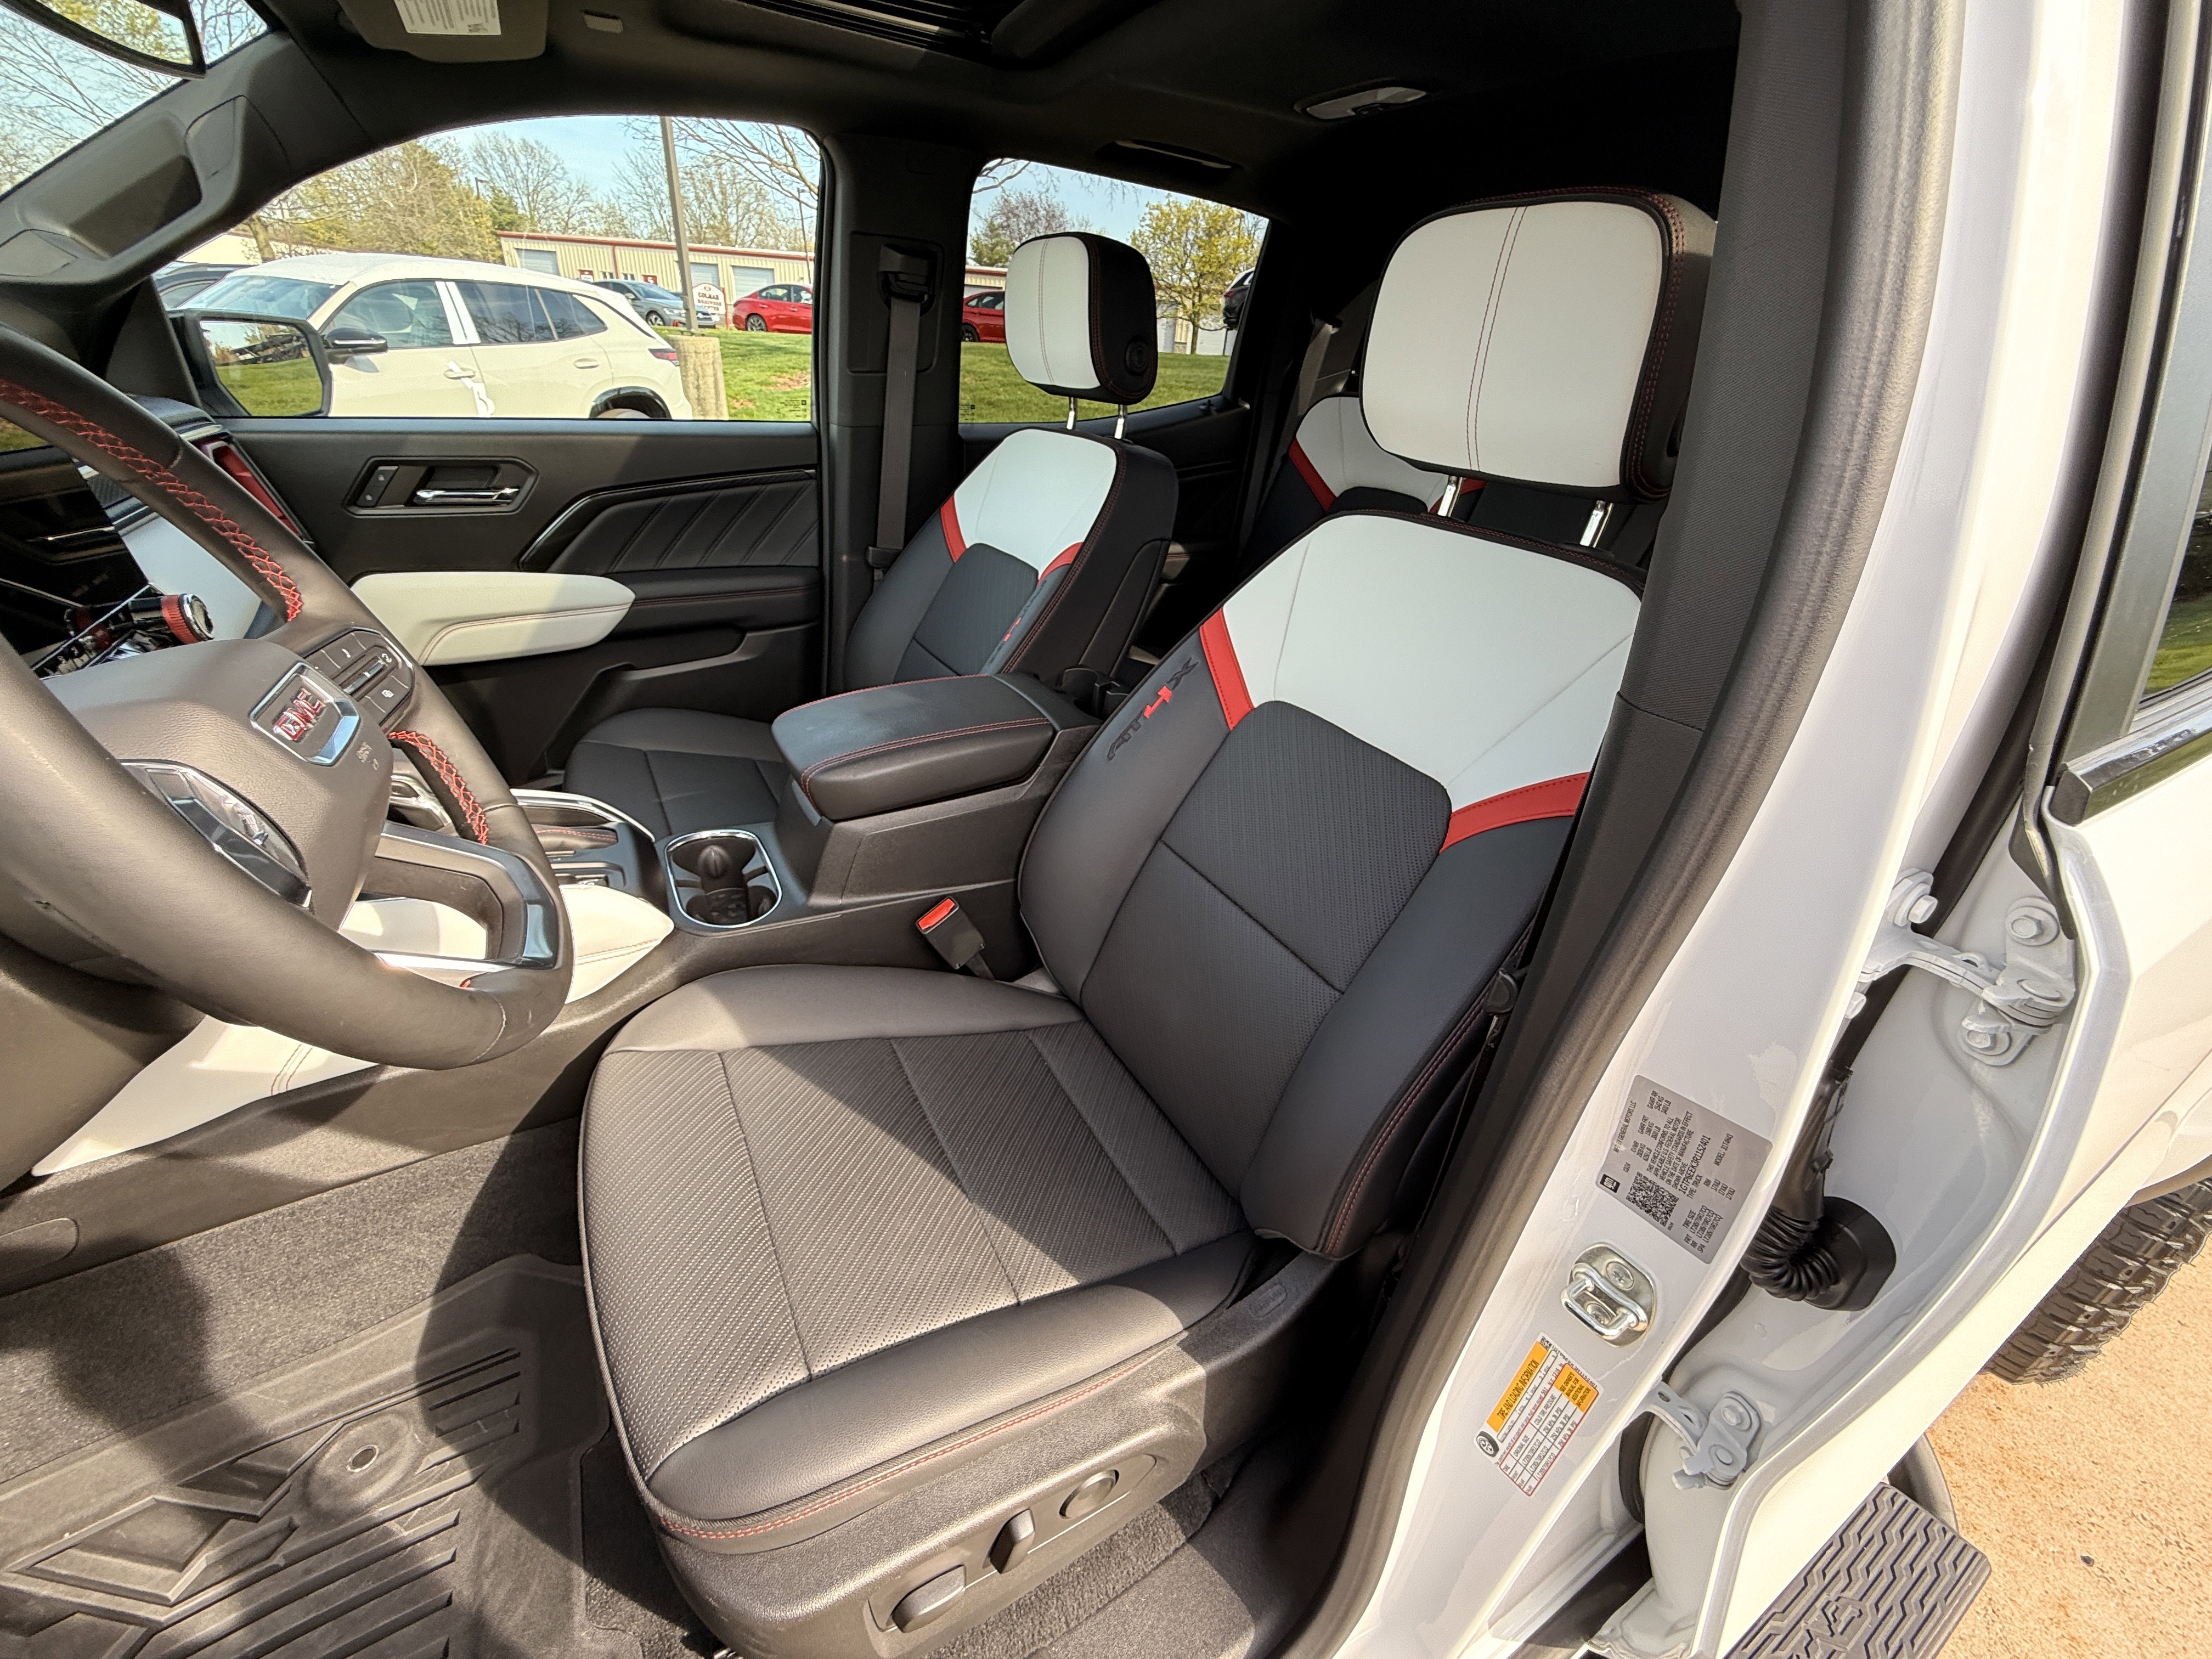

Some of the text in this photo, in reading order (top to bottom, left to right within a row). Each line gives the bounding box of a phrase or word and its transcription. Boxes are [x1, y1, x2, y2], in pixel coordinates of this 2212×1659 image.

[273, 687, 326, 742] GMC
[1107, 657, 1199, 761] AT4X
[1628, 1099, 1637, 1109] LLC
[1623, 1107, 1634, 1124] MOTORS
[1641, 1114, 1649, 1124] FRT
[1647, 1120, 1655, 1128] KG
[1617, 1121, 1628, 1141] GENERAL
[1639, 1142, 1646, 1150] KG
[1645, 1146, 1652, 1154] LB
[1646, 1115, 1674, 1173] THIS VEHICLE CONFORMS TO ALL
[1652, 1154, 1666, 1177] APPLICABLE
[1664, 1130, 1676, 1149] FEDERAL
[1671, 1116, 1682, 1132] MOTOR
[1658, 1164, 1670, 1182] VEHICLE
[1664, 1150, 1676, 1166] SAFETY
[1671, 1129, 1685, 1153] STANDARDS
[1681, 1110, 1694, 1127] EFFECT
[1664, 1128, 1694, 1186] ON THE DATE OF MANUFACTURE
[1677, 1133, 1712, 1195] 1GTP6EEK3R1152401
[1671, 1161, 1688, 1190] SHOWN ABOVE
[1691, 1172, 1703, 1188] TRUCK
[1682, 1209, 1696, 1229] TIRE SIZE
[1683, 1233, 1692, 1244] FRT
[1696, 1242, 1706, 1254] SPA
[1518, 1357, 1539, 1387] INFORMATION
[1507, 1381, 1524, 1404] LOADING
[1570, 1382, 1585, 1402] ADDITIONAL
[1575, 1386, 1591, 1408] INFORMATION
[1496, 1407, 1508, 1421] TIRE
[1502, 1398, 1514, 1412] AND
